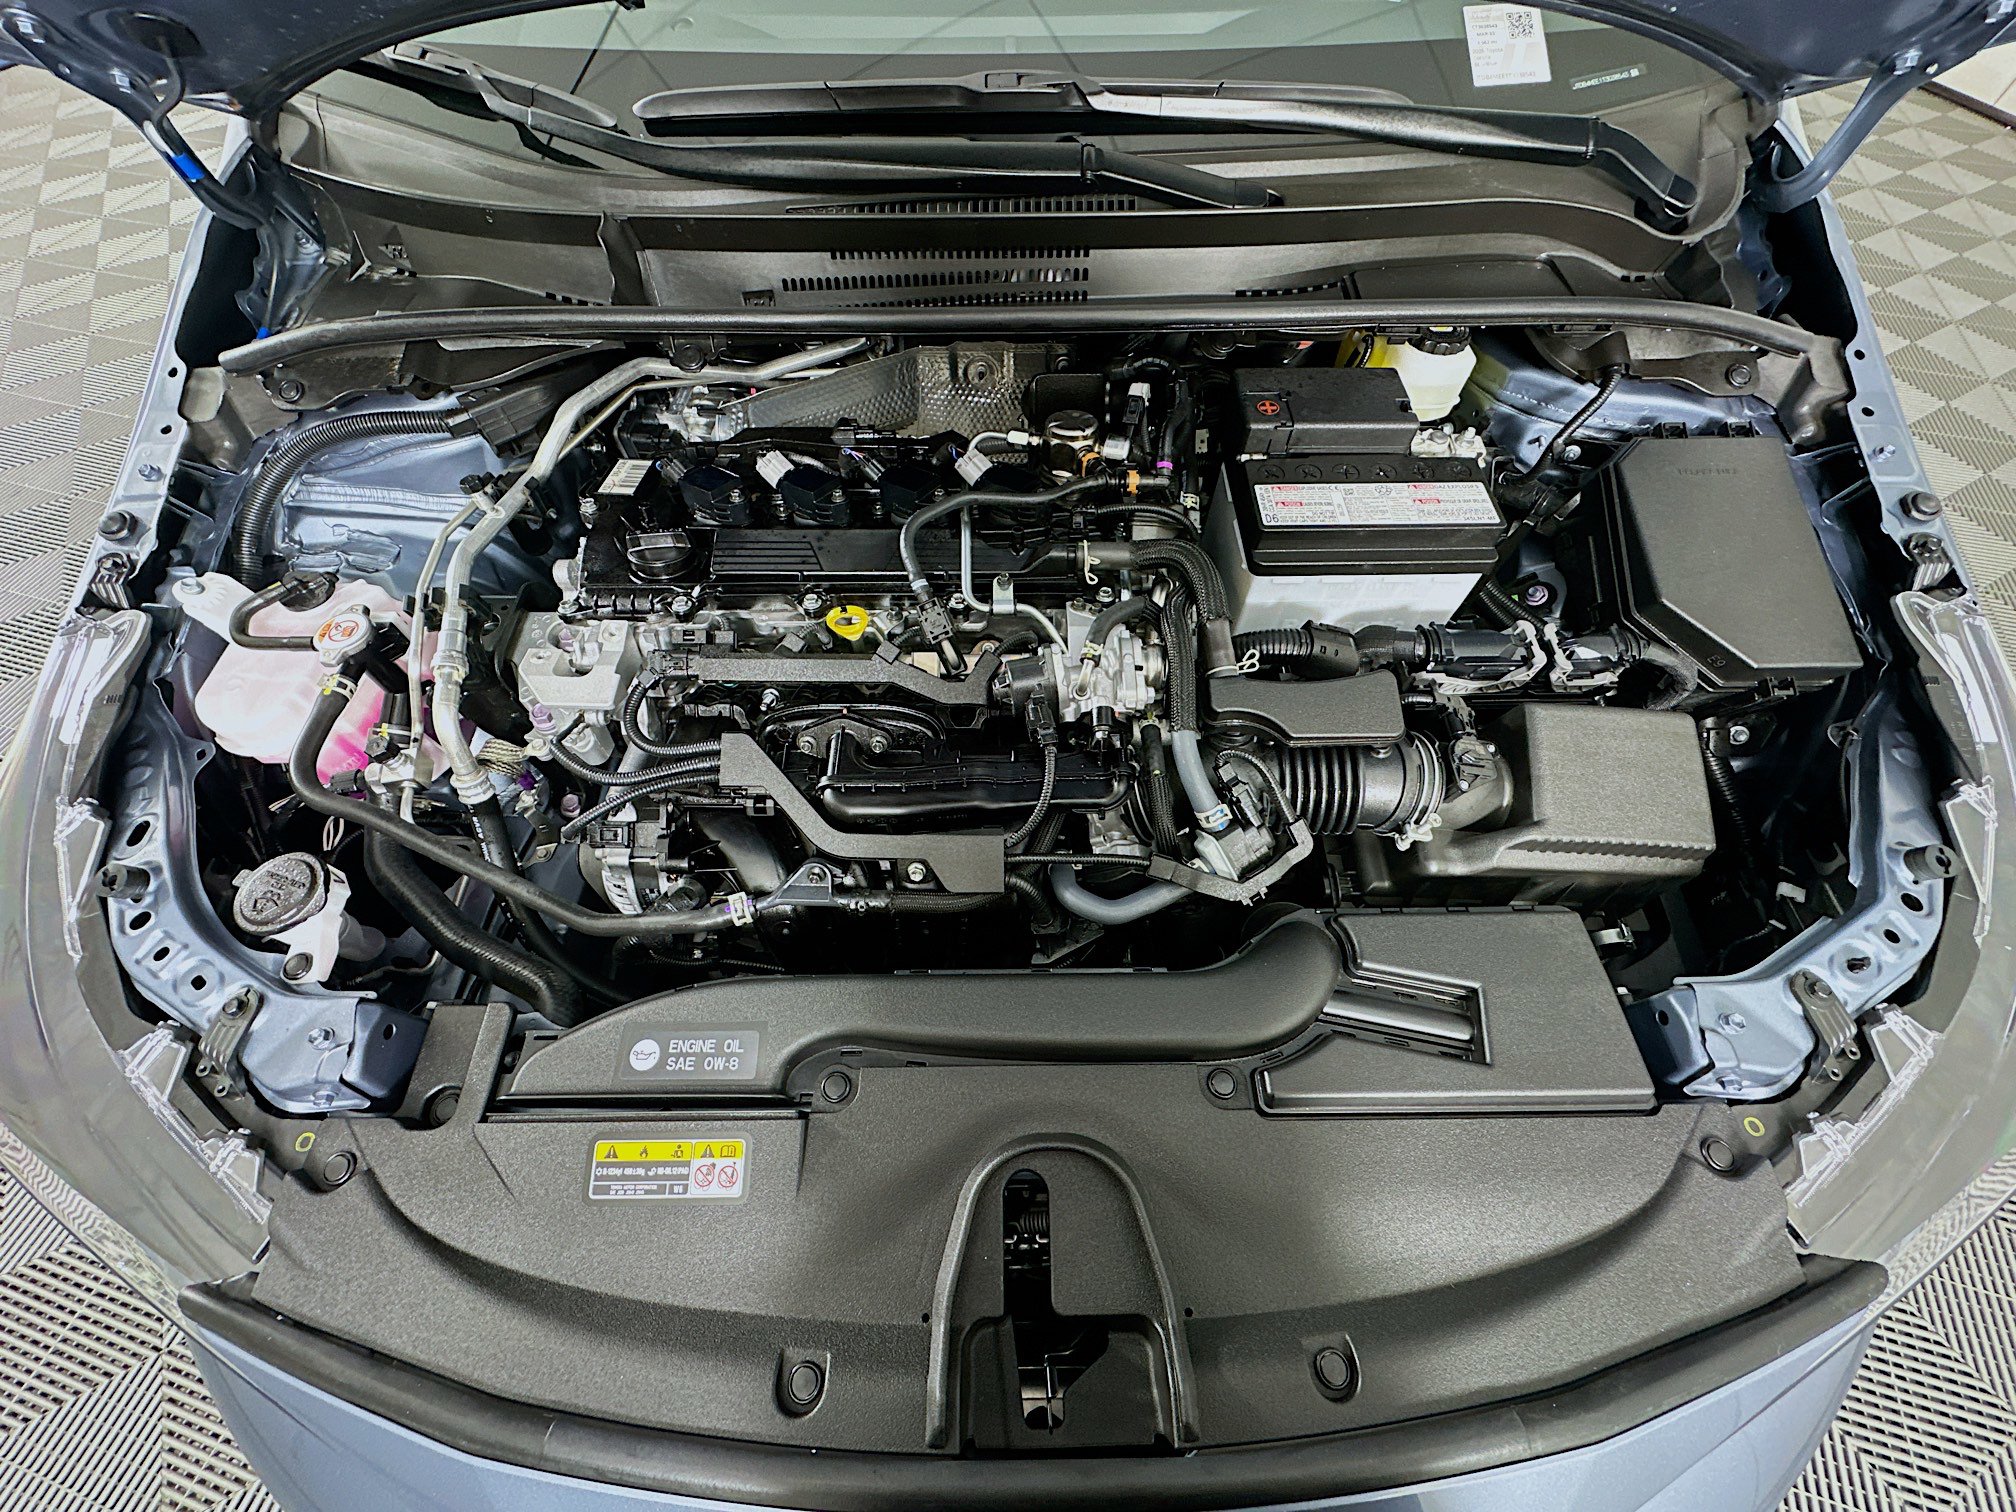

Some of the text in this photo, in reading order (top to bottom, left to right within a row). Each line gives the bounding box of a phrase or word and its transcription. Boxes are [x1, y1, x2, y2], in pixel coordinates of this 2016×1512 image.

[1265, 513, 1279, 523] D6
[668, 1039, 744, 1053] ENGINE OIL
[666, 1057, 739, 1071] SAE 0W-8
